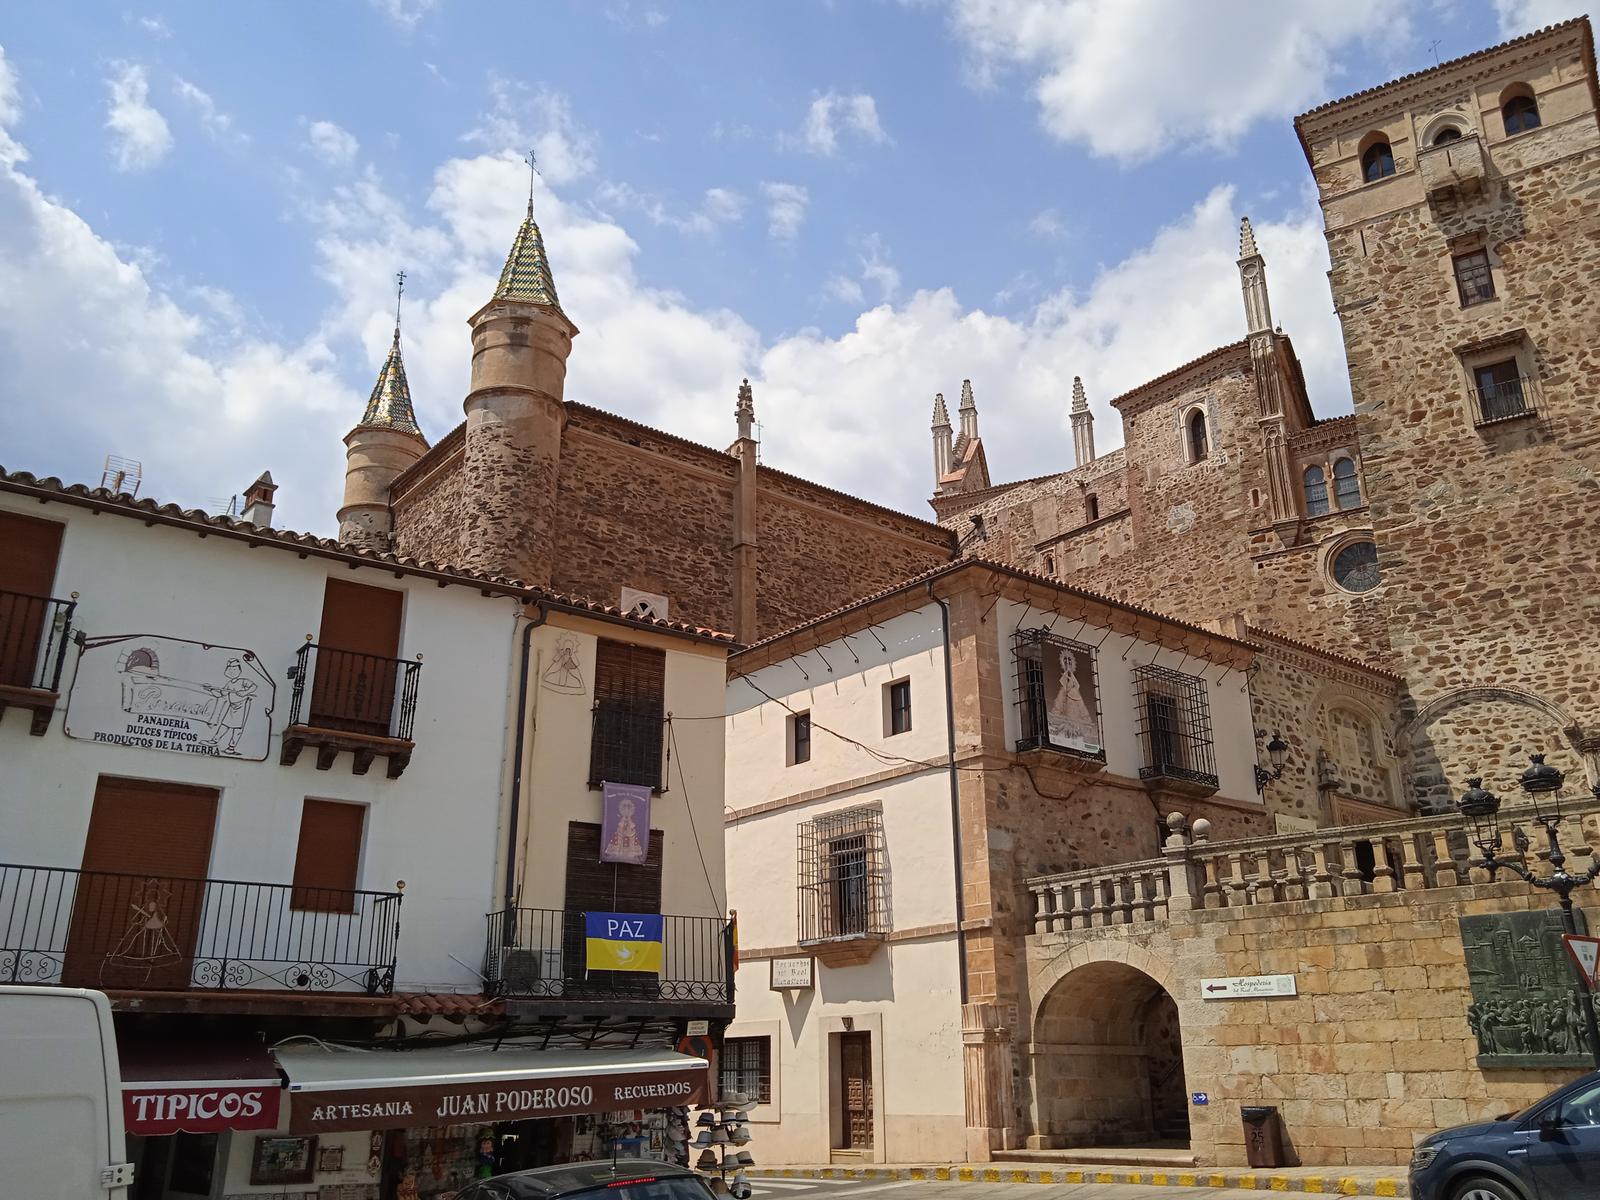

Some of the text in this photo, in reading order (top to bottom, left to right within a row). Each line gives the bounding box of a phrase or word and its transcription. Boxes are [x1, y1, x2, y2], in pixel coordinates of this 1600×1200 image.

[137, 714, 190, 729] PANADERÍA
[93, 731, 220, 756] PRODUCTOS DE LA TIERRA
[126, 724, 198, 742] DULCES TÍPICOS
[608, 919, 645, 938] PAZ
[132, 1092, 263, 1121] TIPICOS
[311, 1082, 691, 1121] ARTESANIA JUAN PODEROSO RECUERDOS
